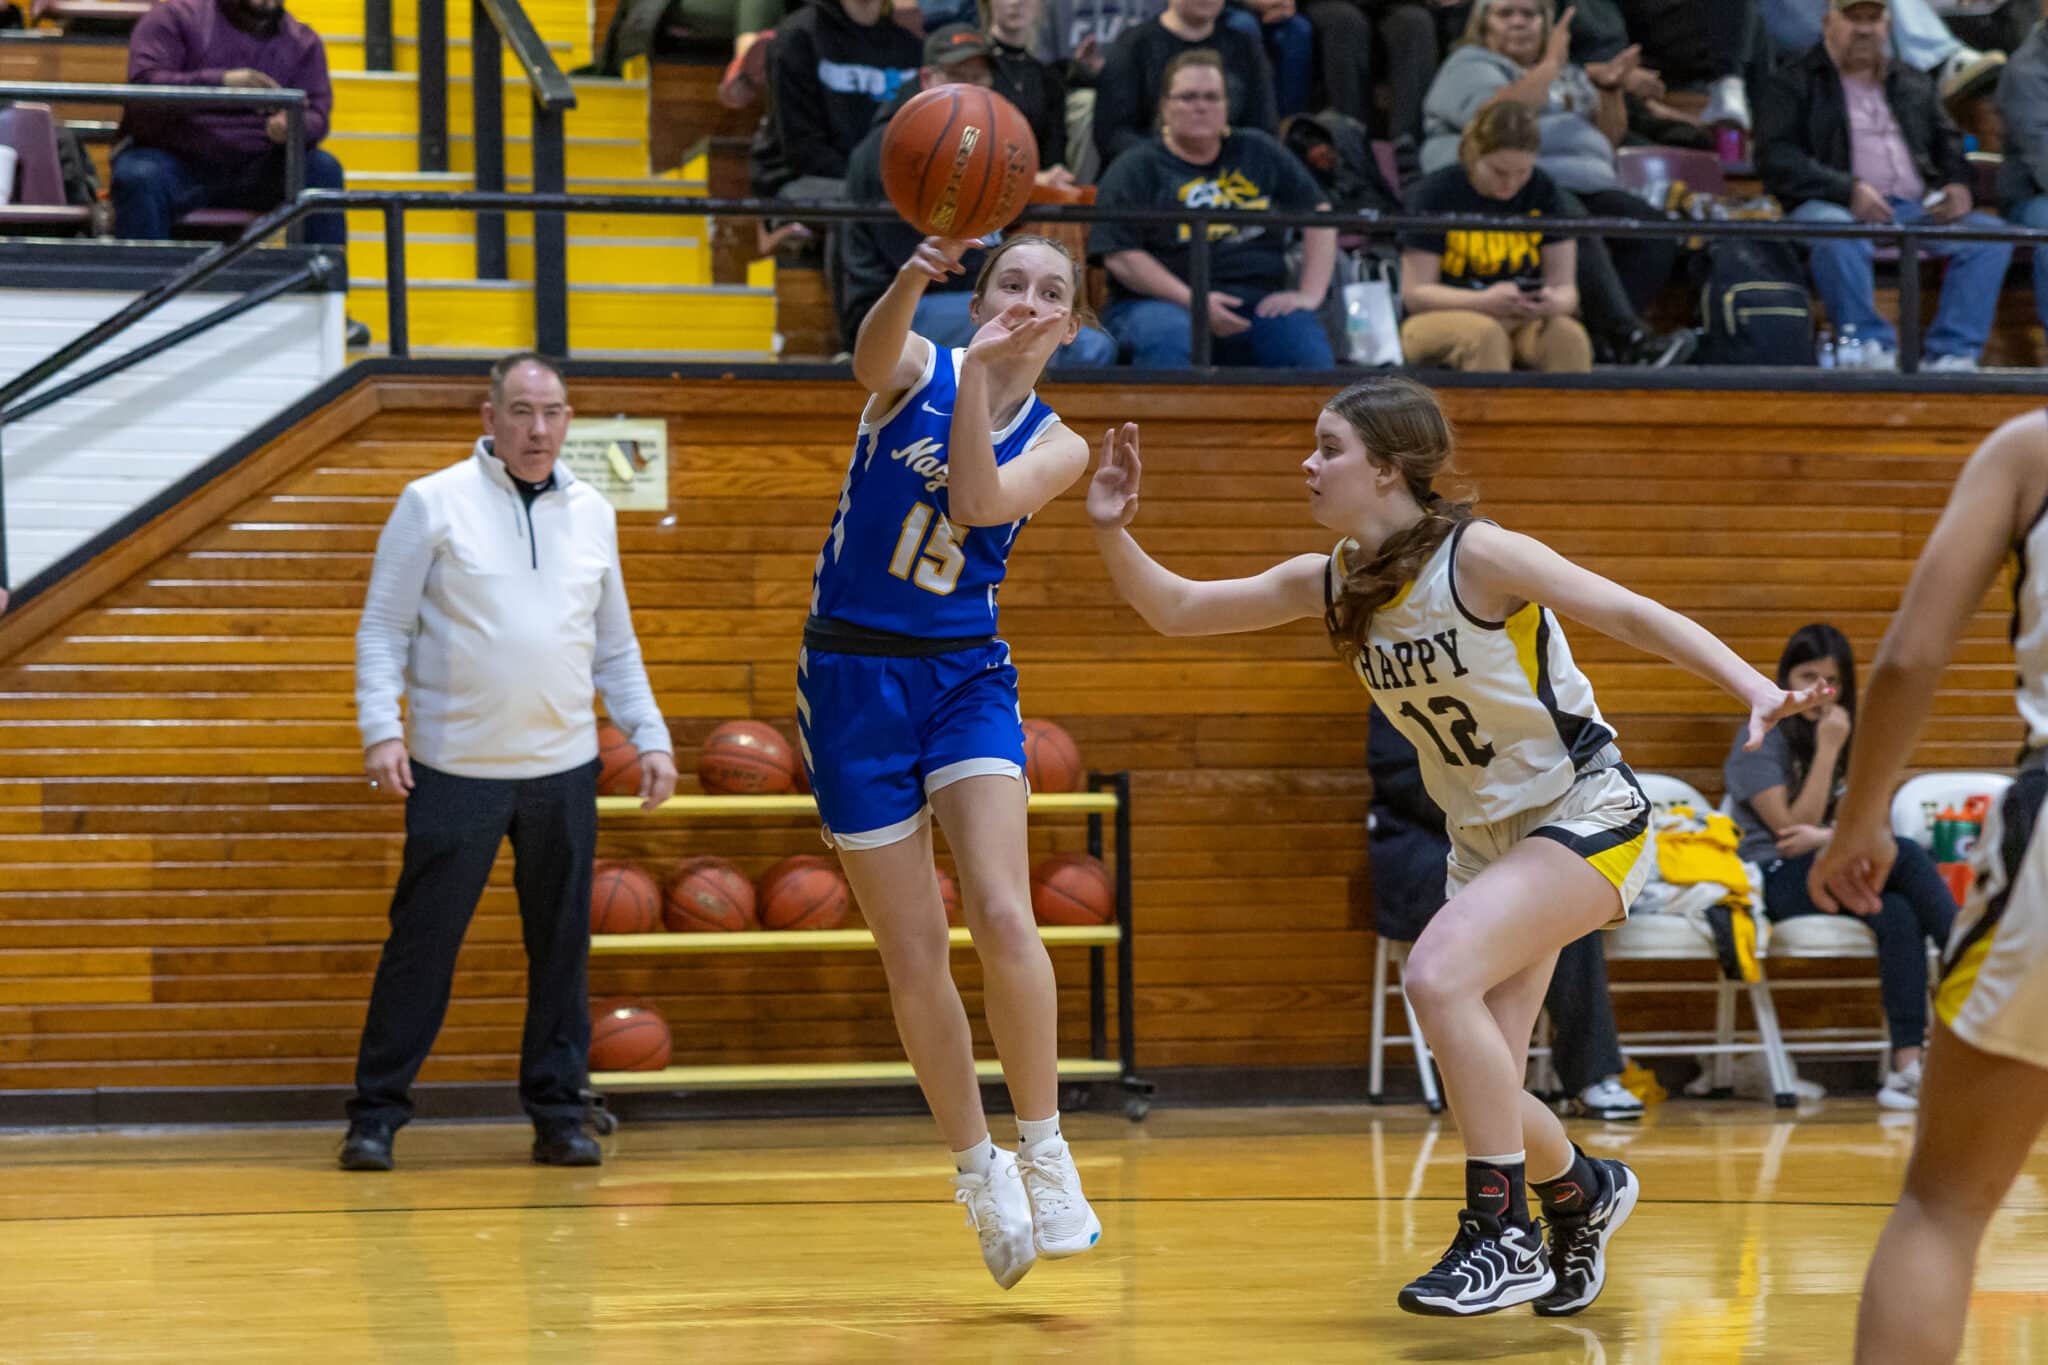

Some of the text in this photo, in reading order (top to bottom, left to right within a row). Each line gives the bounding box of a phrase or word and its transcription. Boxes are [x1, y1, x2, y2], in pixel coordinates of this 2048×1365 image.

[891, 437, 950, 492] Naz
[888, 501, 970, 596] 15
[1359, 628, 1469, 690] HAPPY
[1399, 696, 1496, 768] 12
